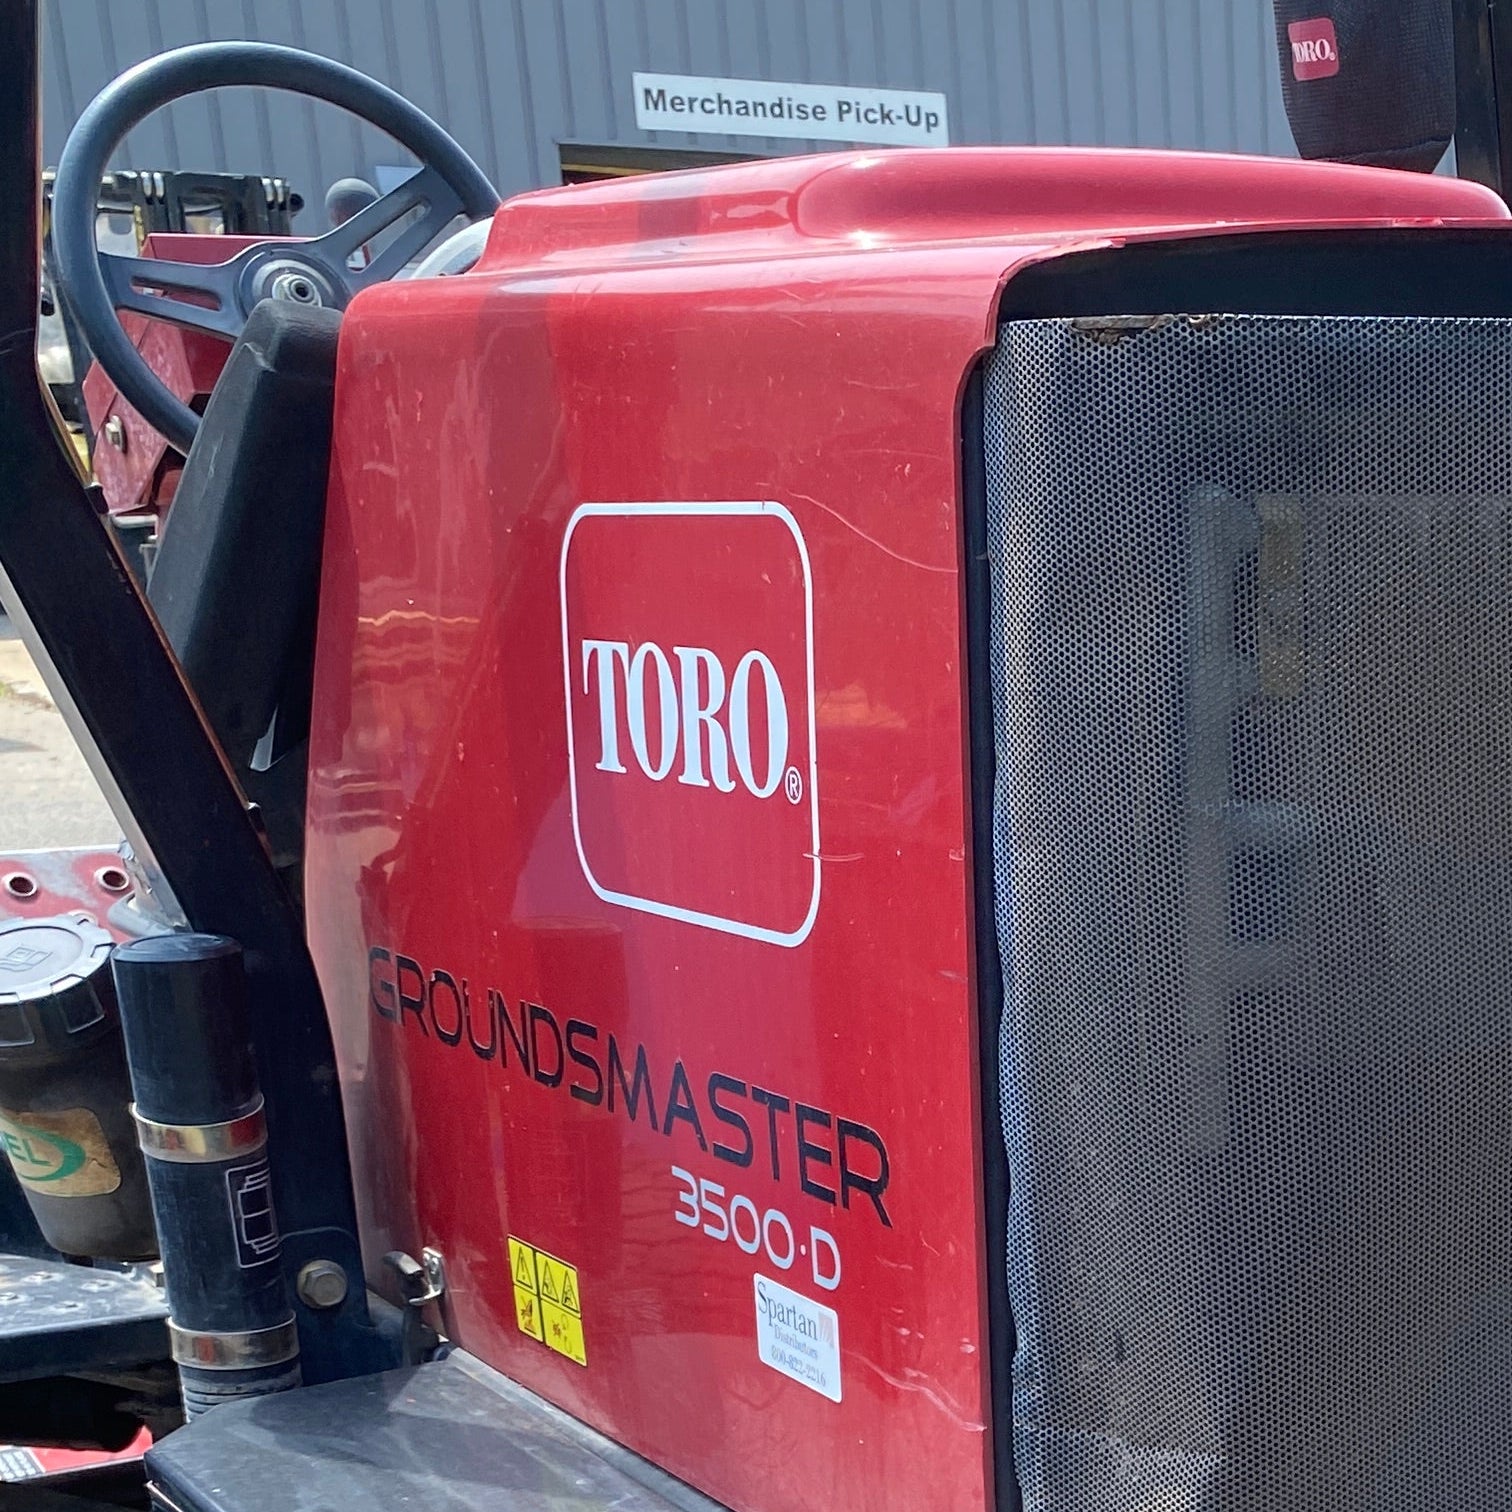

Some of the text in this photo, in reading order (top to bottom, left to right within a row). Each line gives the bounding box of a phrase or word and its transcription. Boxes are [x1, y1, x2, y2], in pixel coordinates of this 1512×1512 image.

[643, 88, 939, 133] Merchandise Pick-Up
[368, 946, 893, 1229] GROUNDSMASTER
[757, 1281, 818, 1341] Spartan
[774, 1325, 818, 1360] Distributors
